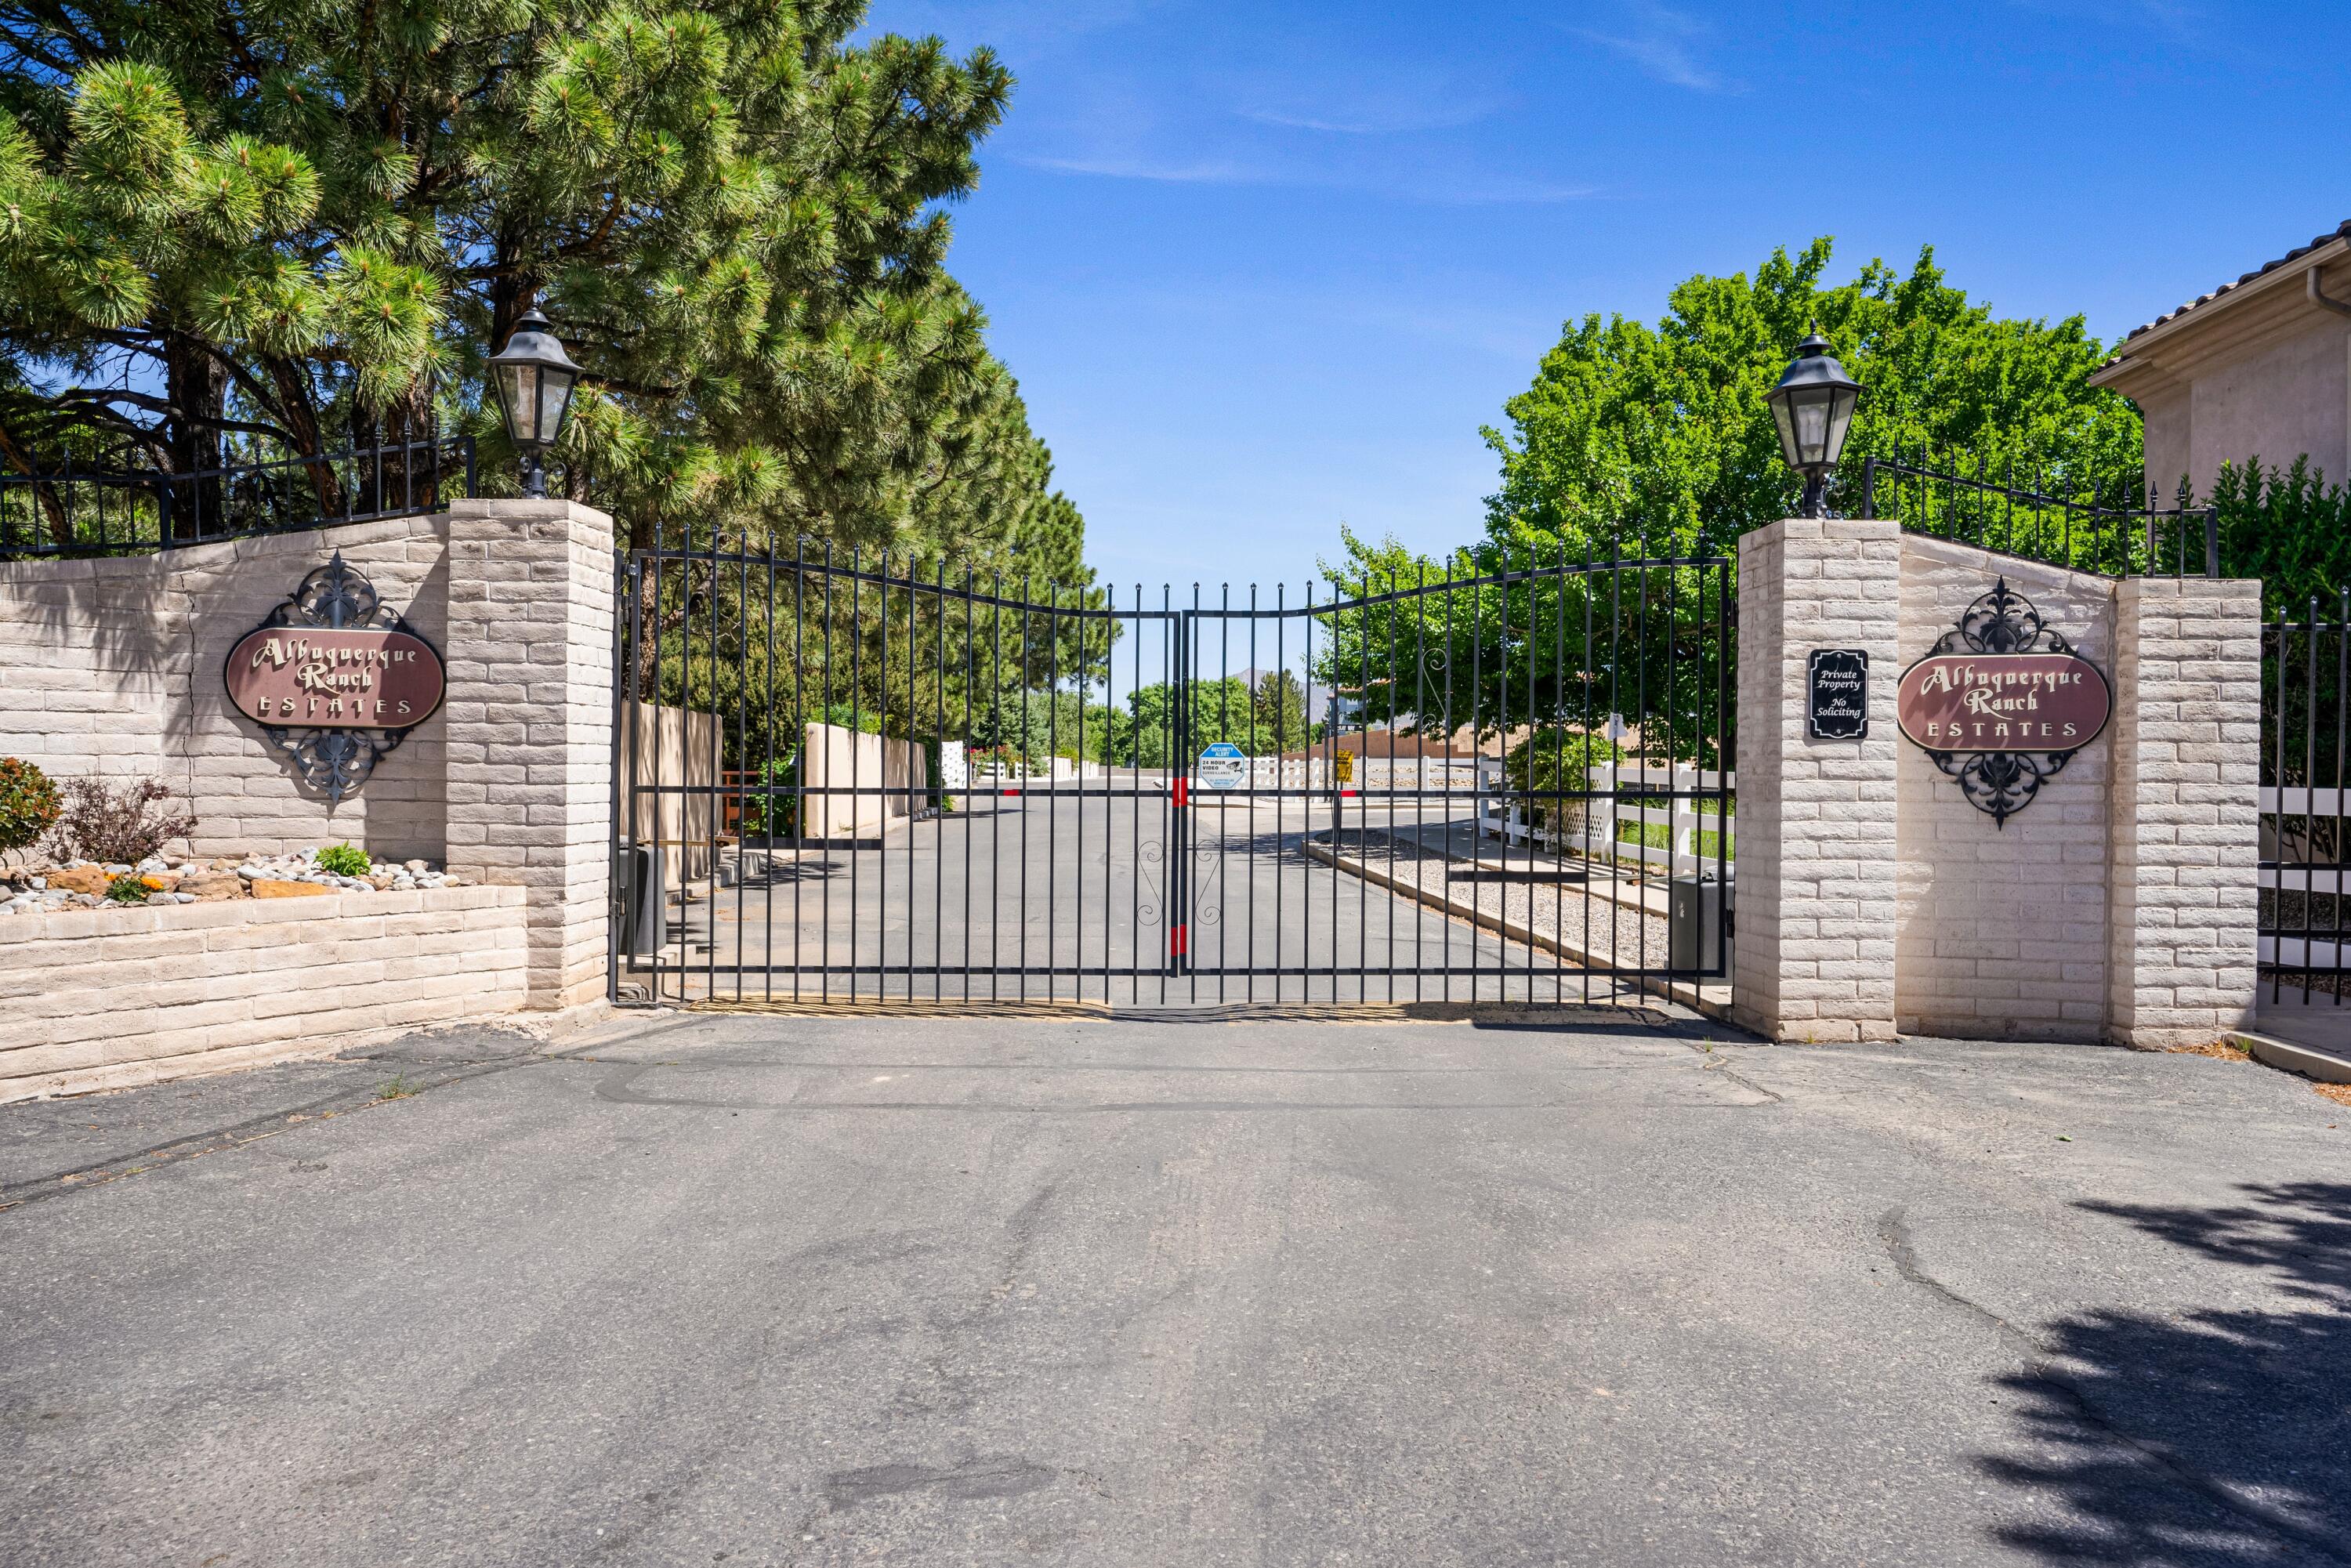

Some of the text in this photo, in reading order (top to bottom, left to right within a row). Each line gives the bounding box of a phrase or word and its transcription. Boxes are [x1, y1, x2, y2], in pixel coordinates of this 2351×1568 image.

[252, 638, 417, 669] Albuquerque
[297, 662, 372, 696] Ranch
[1820, 668, 1857, 679] Private
[1920, 664, 2082, 695] Albuquerque
[1817, 679, 1860, 691] Property
[259, 697, 411, 714] ESTATES
[1831, 697, 1847, 707] No
[1964, 688, 2038, 719] Ranch
[1817, 706, 1861, 719] Soliciting
[1927, 722, 2077, 737] ESTATES
